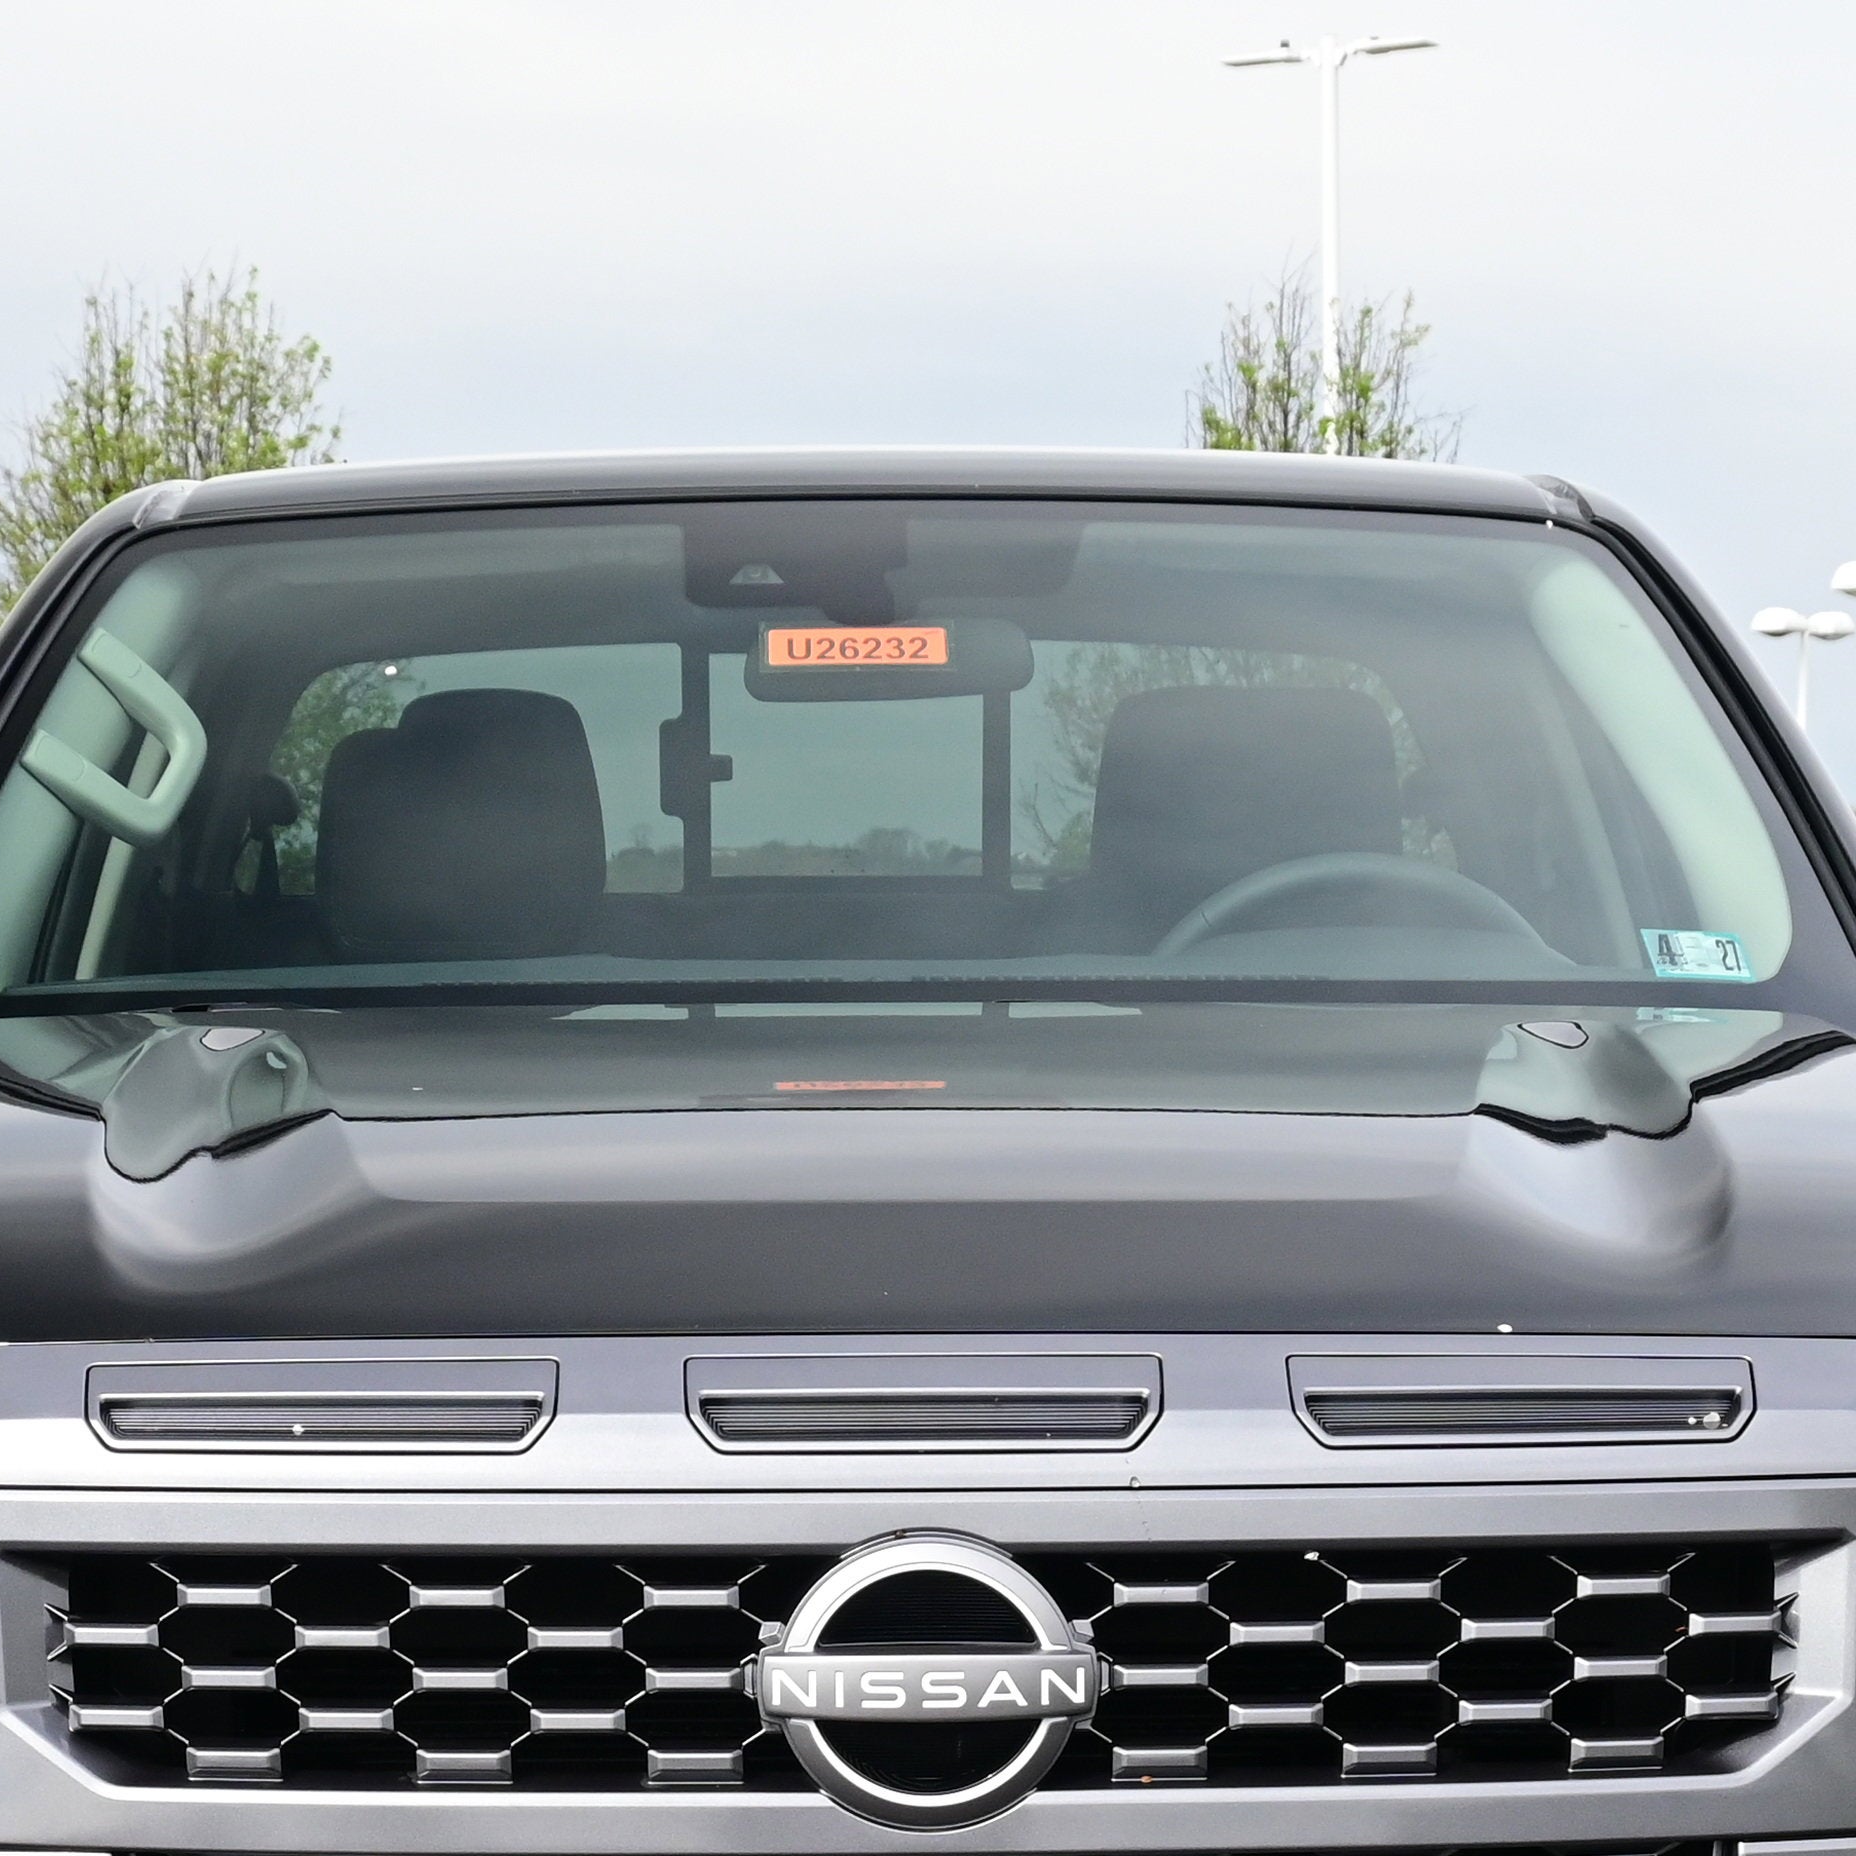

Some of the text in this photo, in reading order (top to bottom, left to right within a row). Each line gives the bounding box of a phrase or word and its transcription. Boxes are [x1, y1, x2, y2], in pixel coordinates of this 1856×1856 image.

[786, 636, 930, 660] U26232
[1714, 939, 1742, 972] 27
[770, 1667, 1086, 1709] NISSAN
